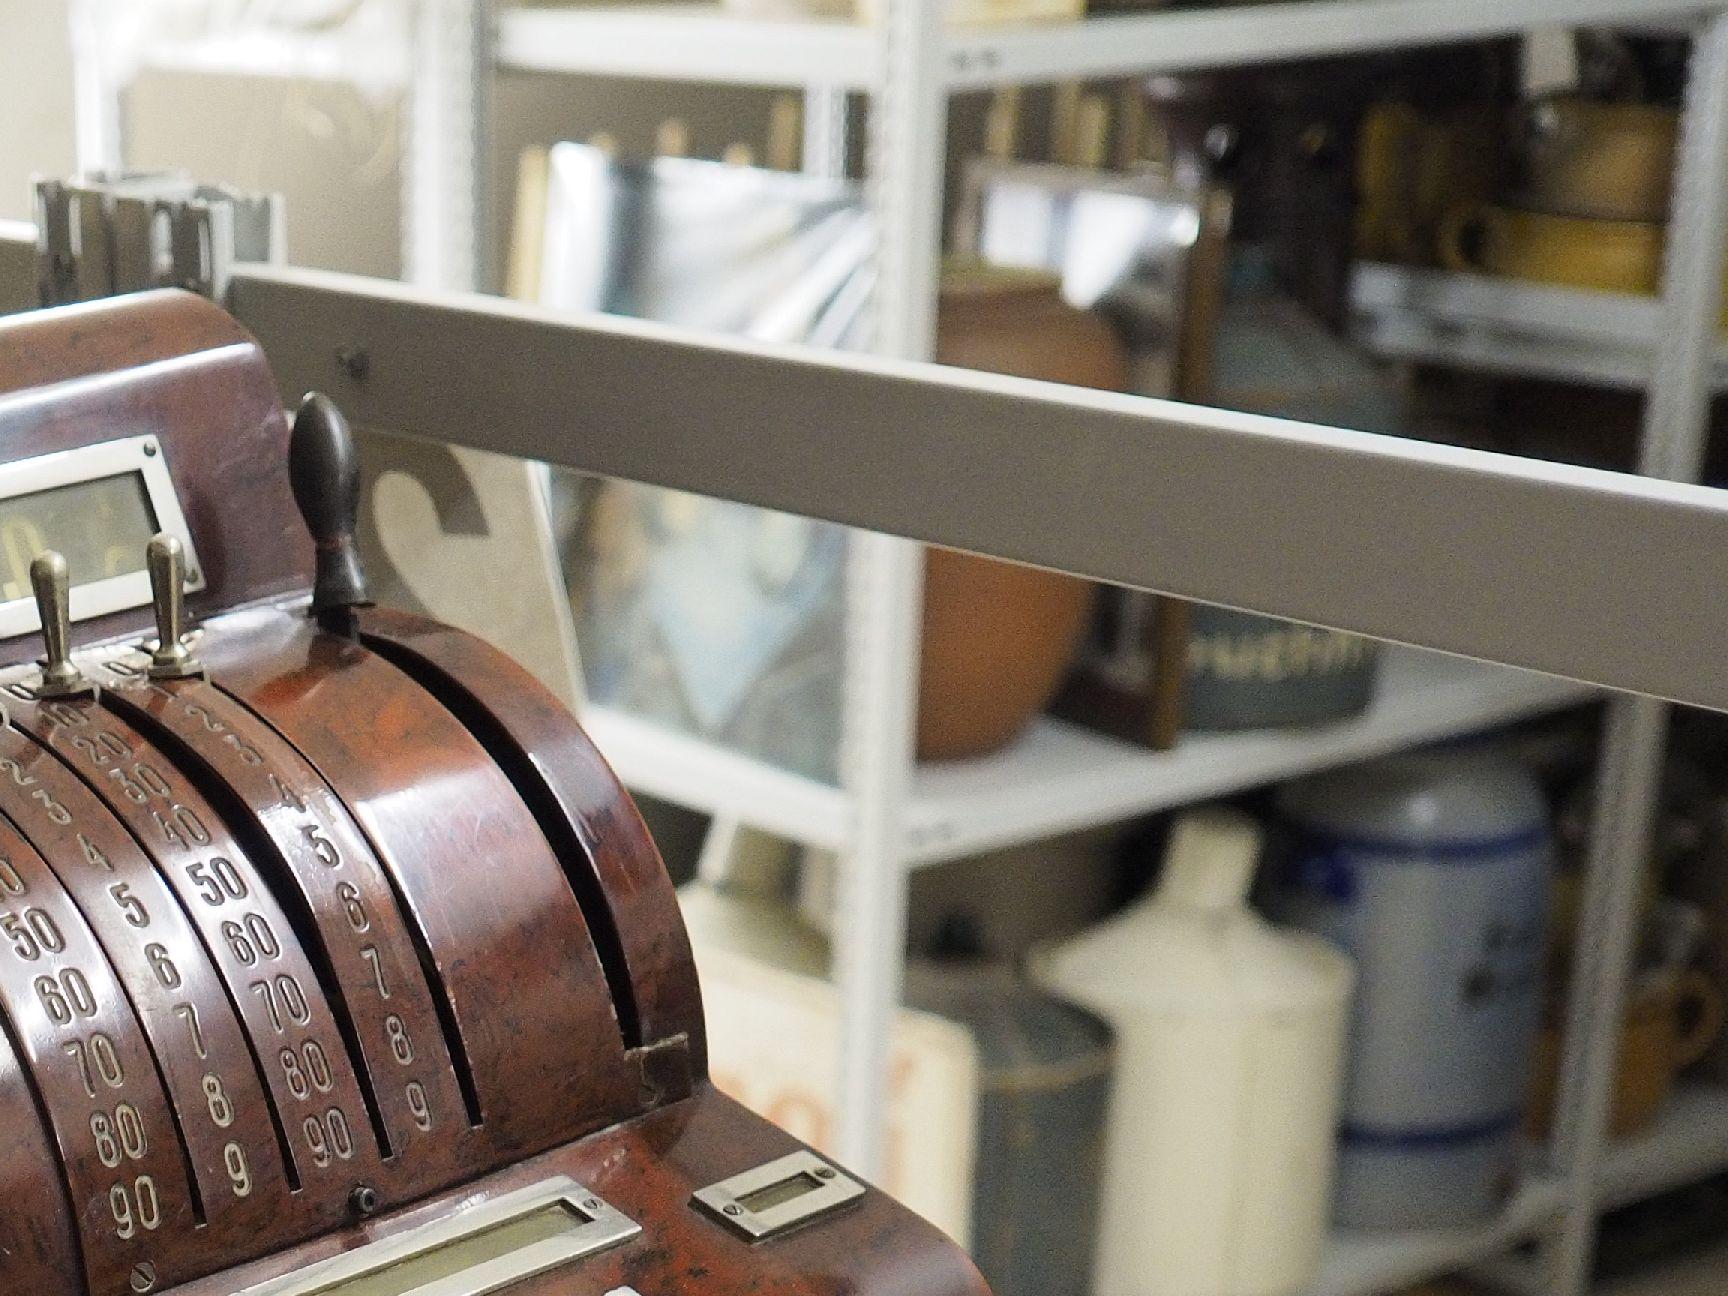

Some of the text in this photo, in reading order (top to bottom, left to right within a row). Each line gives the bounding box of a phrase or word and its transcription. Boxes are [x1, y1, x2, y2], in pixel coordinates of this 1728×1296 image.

[184, 703, 227, 733] 2
[72, 730, 133, 765] 20
[222, 733, 264, 768] 3
[32, 788, 73, 826] 3
[108, 762, 172, 804] 30
[267, 772, 308, 813] 4
[76, 832, 116, 873] 4
[147, 804, 213, 852] 40
[299, 822, 342, 870] 5
[108, 880, 151, 930] 5
[184, 856, 249, 908] 50
[335, 880, 371, 935] 6
[143, 941, 184, 991] 6
[219, 913, 284, 968] 60
[33, 966, 97, 1026] 60
[359, 945, 391, 1000] 7
[248, 973, 313, 1034] 70
[171, 1003, 209, 1060] 7
[385, 1013, 414, 1067] 8
[64, 1031, 124, 1098] 70
[278, 1037, 334, 1102] 80
[200, 1072, 234, 1127] 8
[404, 1080, 434, 1133] 9
[88, 1102, 149, 1168] 80
[301, 1106, 355, 1169] 90
[222, 1141, 254, 1199] 9
[108, 1174, 161, 1240] 90
